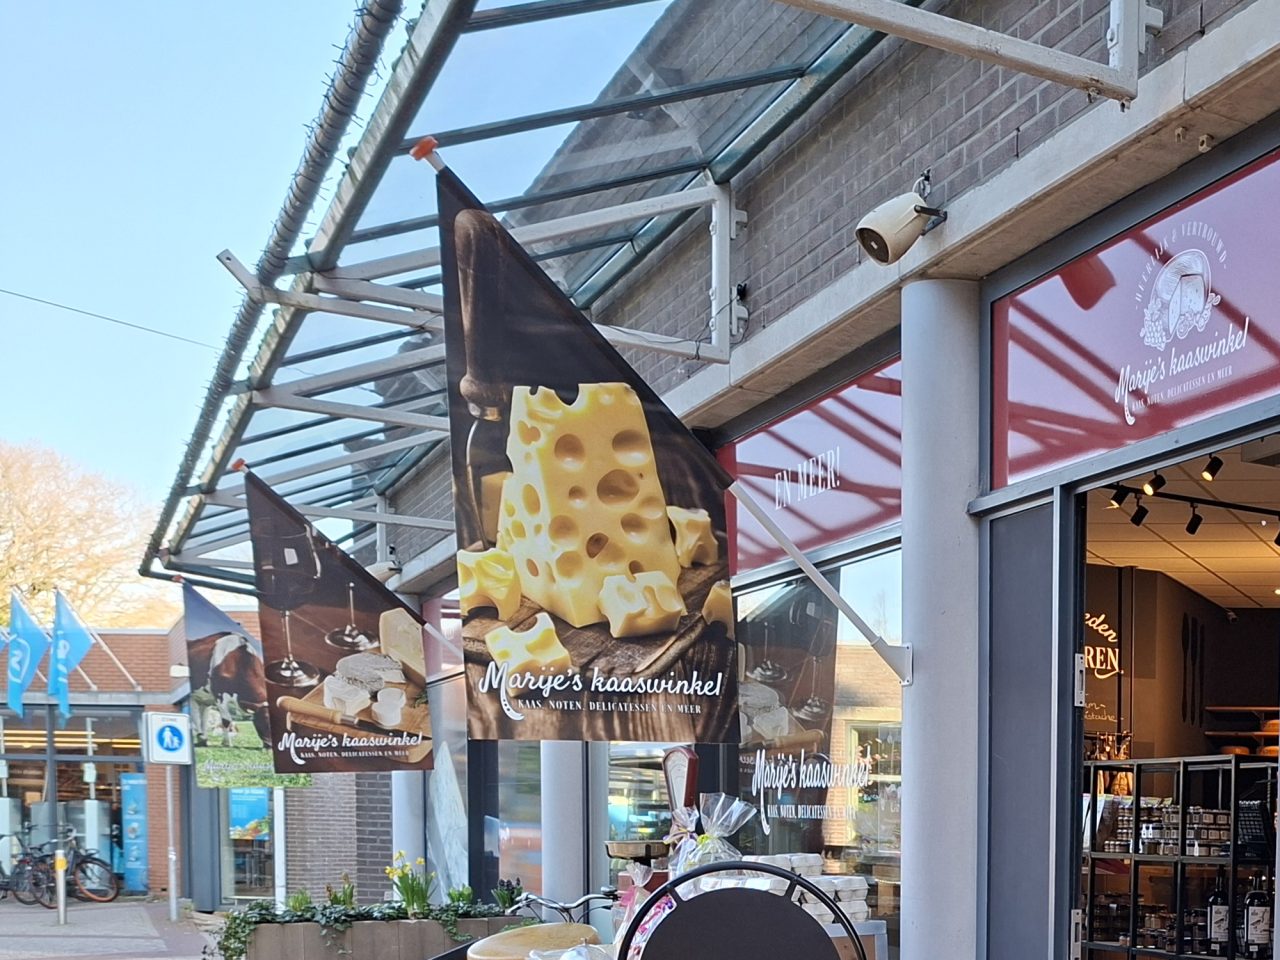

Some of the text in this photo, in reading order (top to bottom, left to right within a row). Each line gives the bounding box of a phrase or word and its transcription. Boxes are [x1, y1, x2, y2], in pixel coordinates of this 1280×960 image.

[1169, 316, 1249, 376] kaaswinkel
[775, 446, 840, 510] EN MEER!
[478, 661, 723, 721] Marije's kaaswinkel
[589, 702, 656, 713] DELICATESSEN
[677, 704, 702, 715] MEER
[342, 732, 423, 748] kaaswinkel
